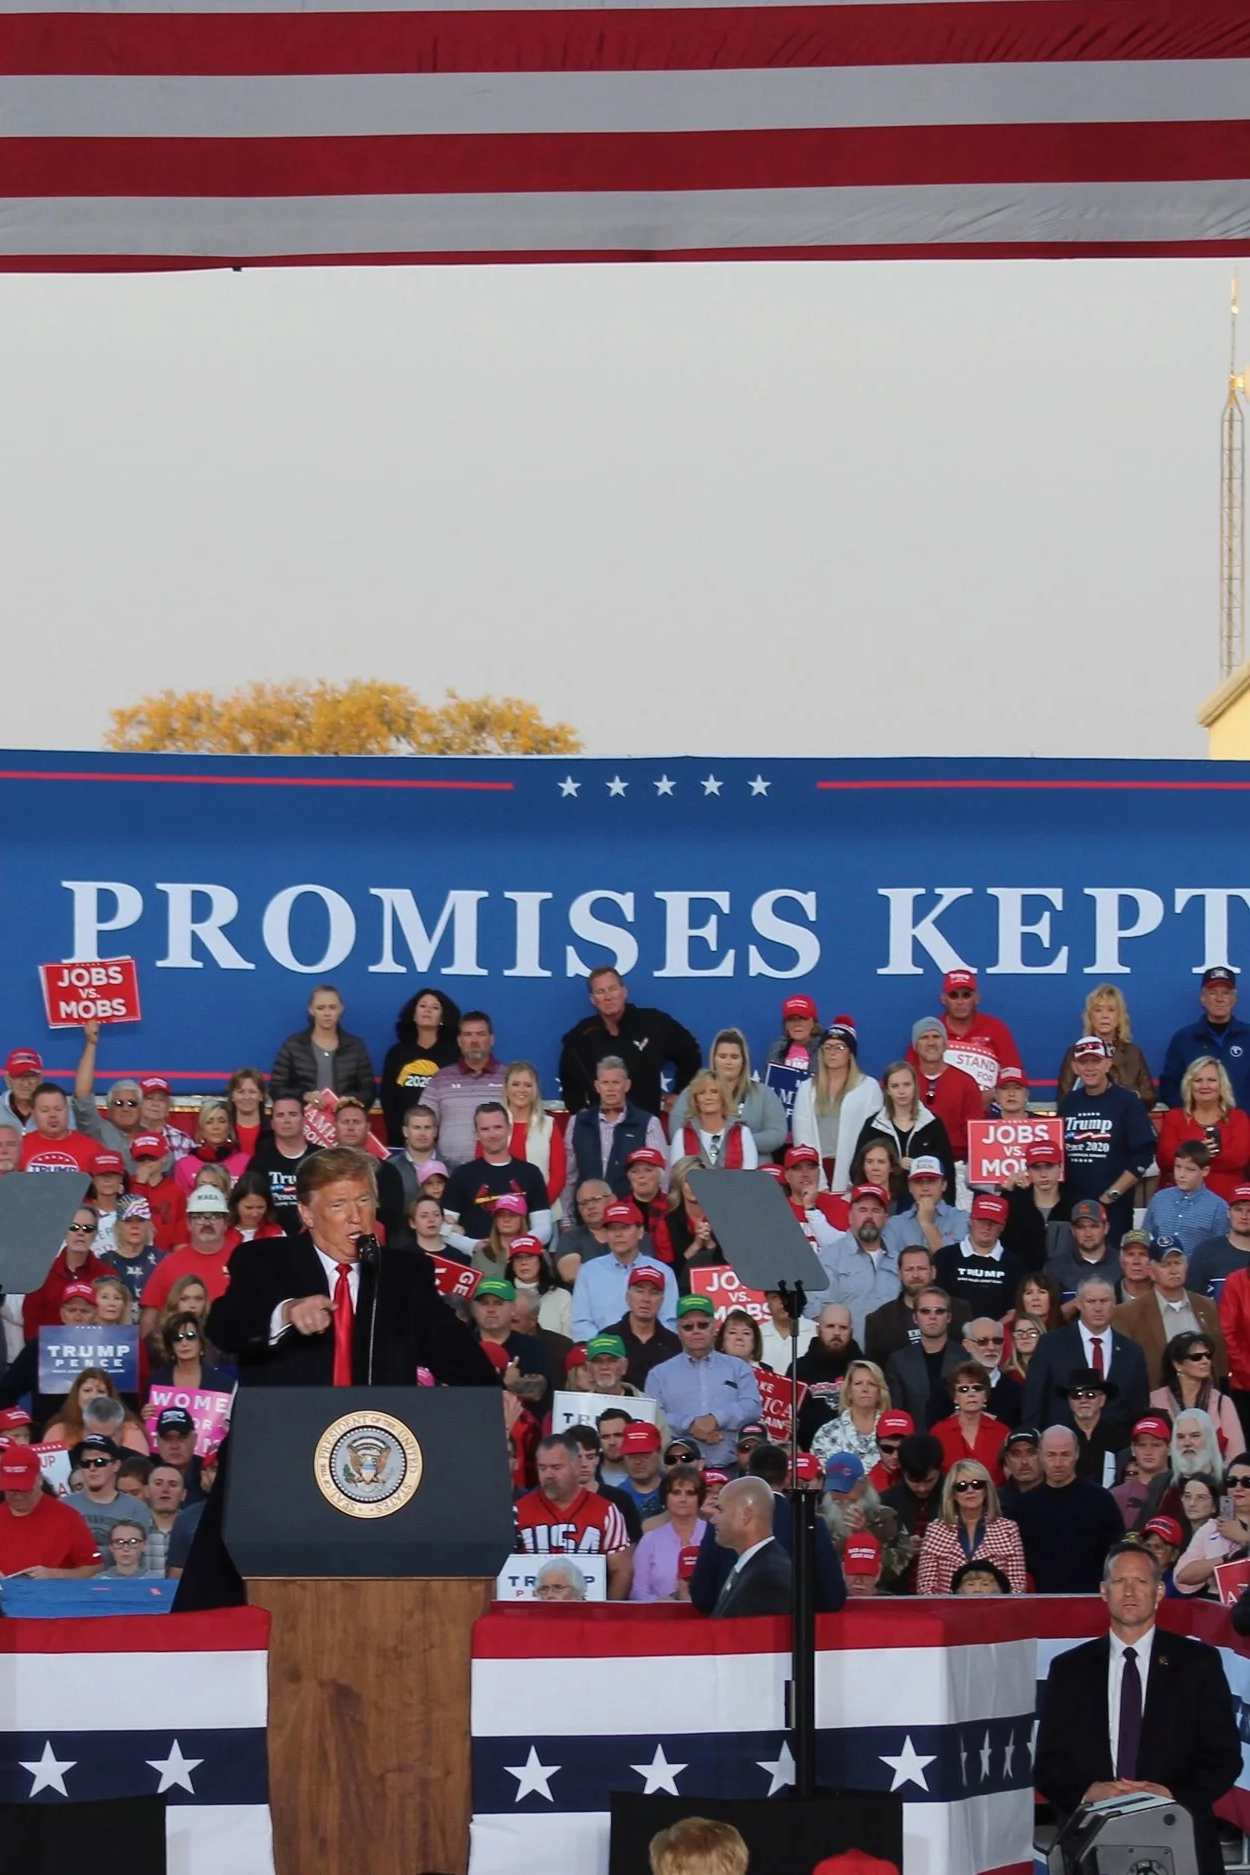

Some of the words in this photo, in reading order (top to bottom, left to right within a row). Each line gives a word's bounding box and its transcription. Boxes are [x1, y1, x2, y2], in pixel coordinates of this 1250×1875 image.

[61, 881, 821, 979] PROMISES
[876, 887, 1250, 975] KEPT
[57, 966, 124, 988] JOBS
[78, 988, 101, 998] VS.
[59, 998, 127, 1019] MOBS
[956, 1054, 996, 1072] STAND
[982, 1124, 1050, 1144] JOBS
[1066, 1116, 1112, 1134] Trump
[1003, 1146, 1026, 1156] VS.
[1086, 1142, 1110, 1152] 2020
[982, 1158, 1027, 1177] MO
[268, 1172, 296, 1184] Tru
[706, 1270, 740, 1292] JO
[957, 1268, 1005, 1278] TRUMP
[728, 1292, 752, 1302] VS.
[47, 1345, 130, 1357] TRUMP
[55, 1358, 123, 1367] PENCE
[759, 1382, 774, 1394] KE
[152, 1391, 228, 1412] WOME
[319, 1415, 368, 1459] PRESIDENT
[397, 1429, 418, 1474] UNITED
[330, 1490, 358, 1513] SEAL
[376, 1484, 412, 1514] STATES
[520, 1524, 600, 1553] USA
[508, 1576, 595, 1587] TRP
